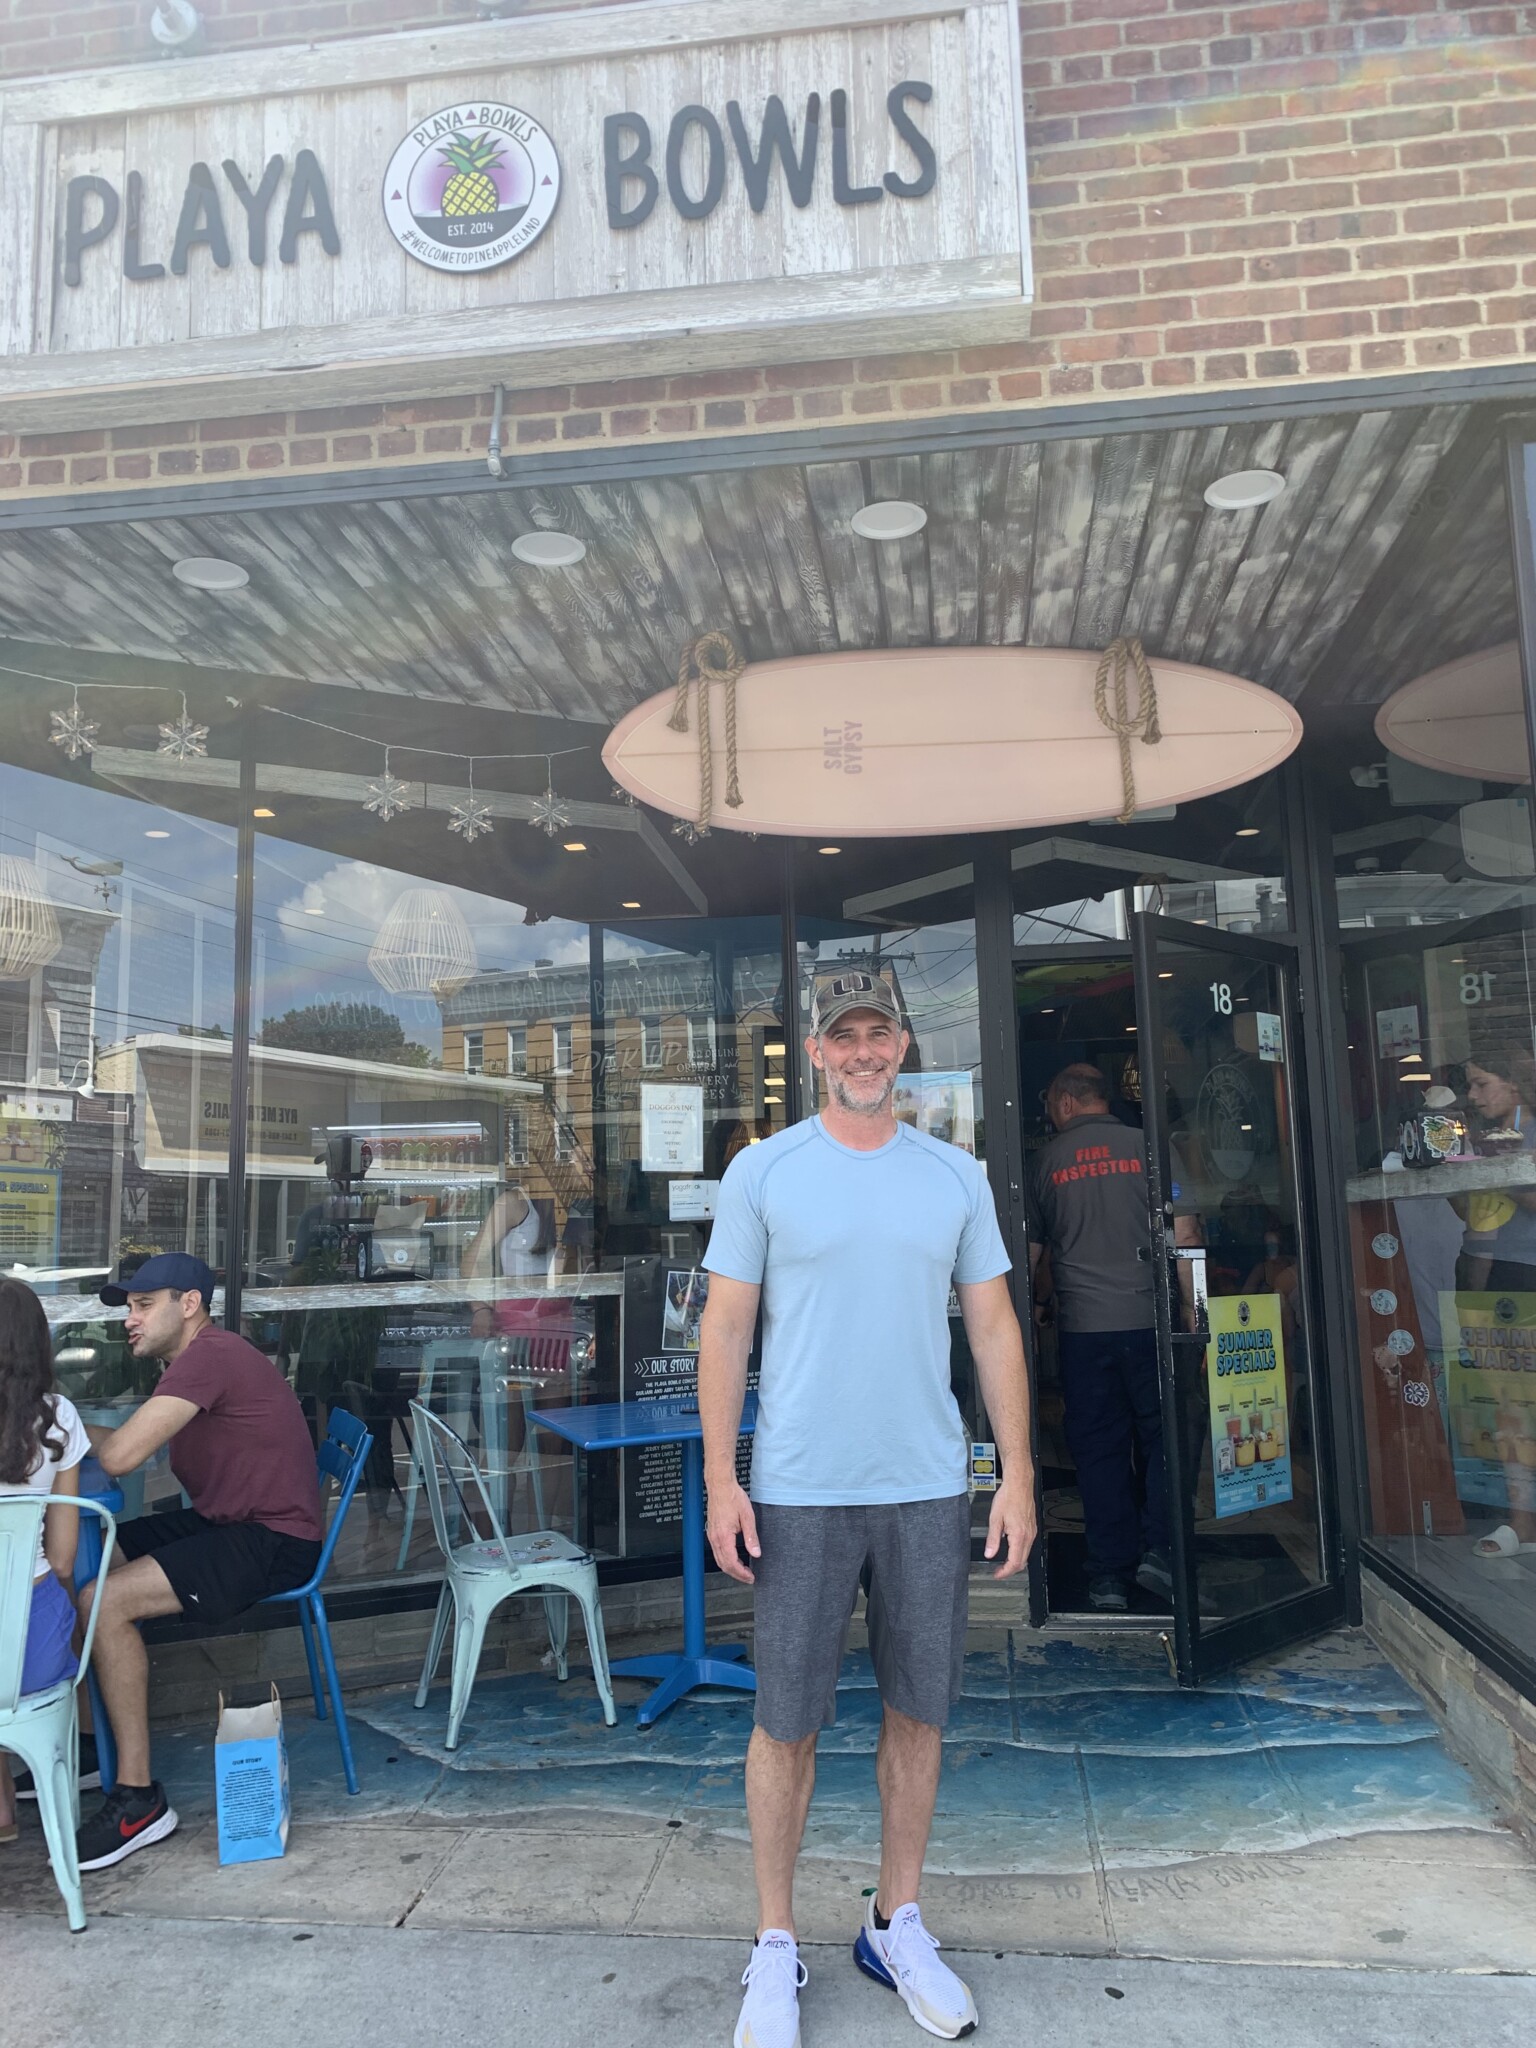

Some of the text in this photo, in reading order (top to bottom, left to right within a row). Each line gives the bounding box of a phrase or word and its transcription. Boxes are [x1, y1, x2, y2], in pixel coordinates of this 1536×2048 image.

[412, 106, 538, 148] PLAYA BOWLS
[64, 80, 936, 288] PLAYA BOWLS
[400, 216, 541, 265] #WELCOMETOPINEAPPLELAND
[447, 221, 494, 237] EST. 2014
[823, 726, 842, 769] SALT
[843, 720, 863, 774] GYPSY
[593, 974, 687, 1016] BANANA
[1209, 982, 1233, 1015] 18
[676, 1062, 717, 1073] ORDERS
[1075, 1145, 1111, 1162] FIRE
[1052, 1158, 1142, 1184] INSPECTOR
[1217, 1329, 1273, 1354] SUMMER
[651, 1358, 695, 1374] OUR STORY
[1216, 1350, 1276, 1376] SPECIALS
